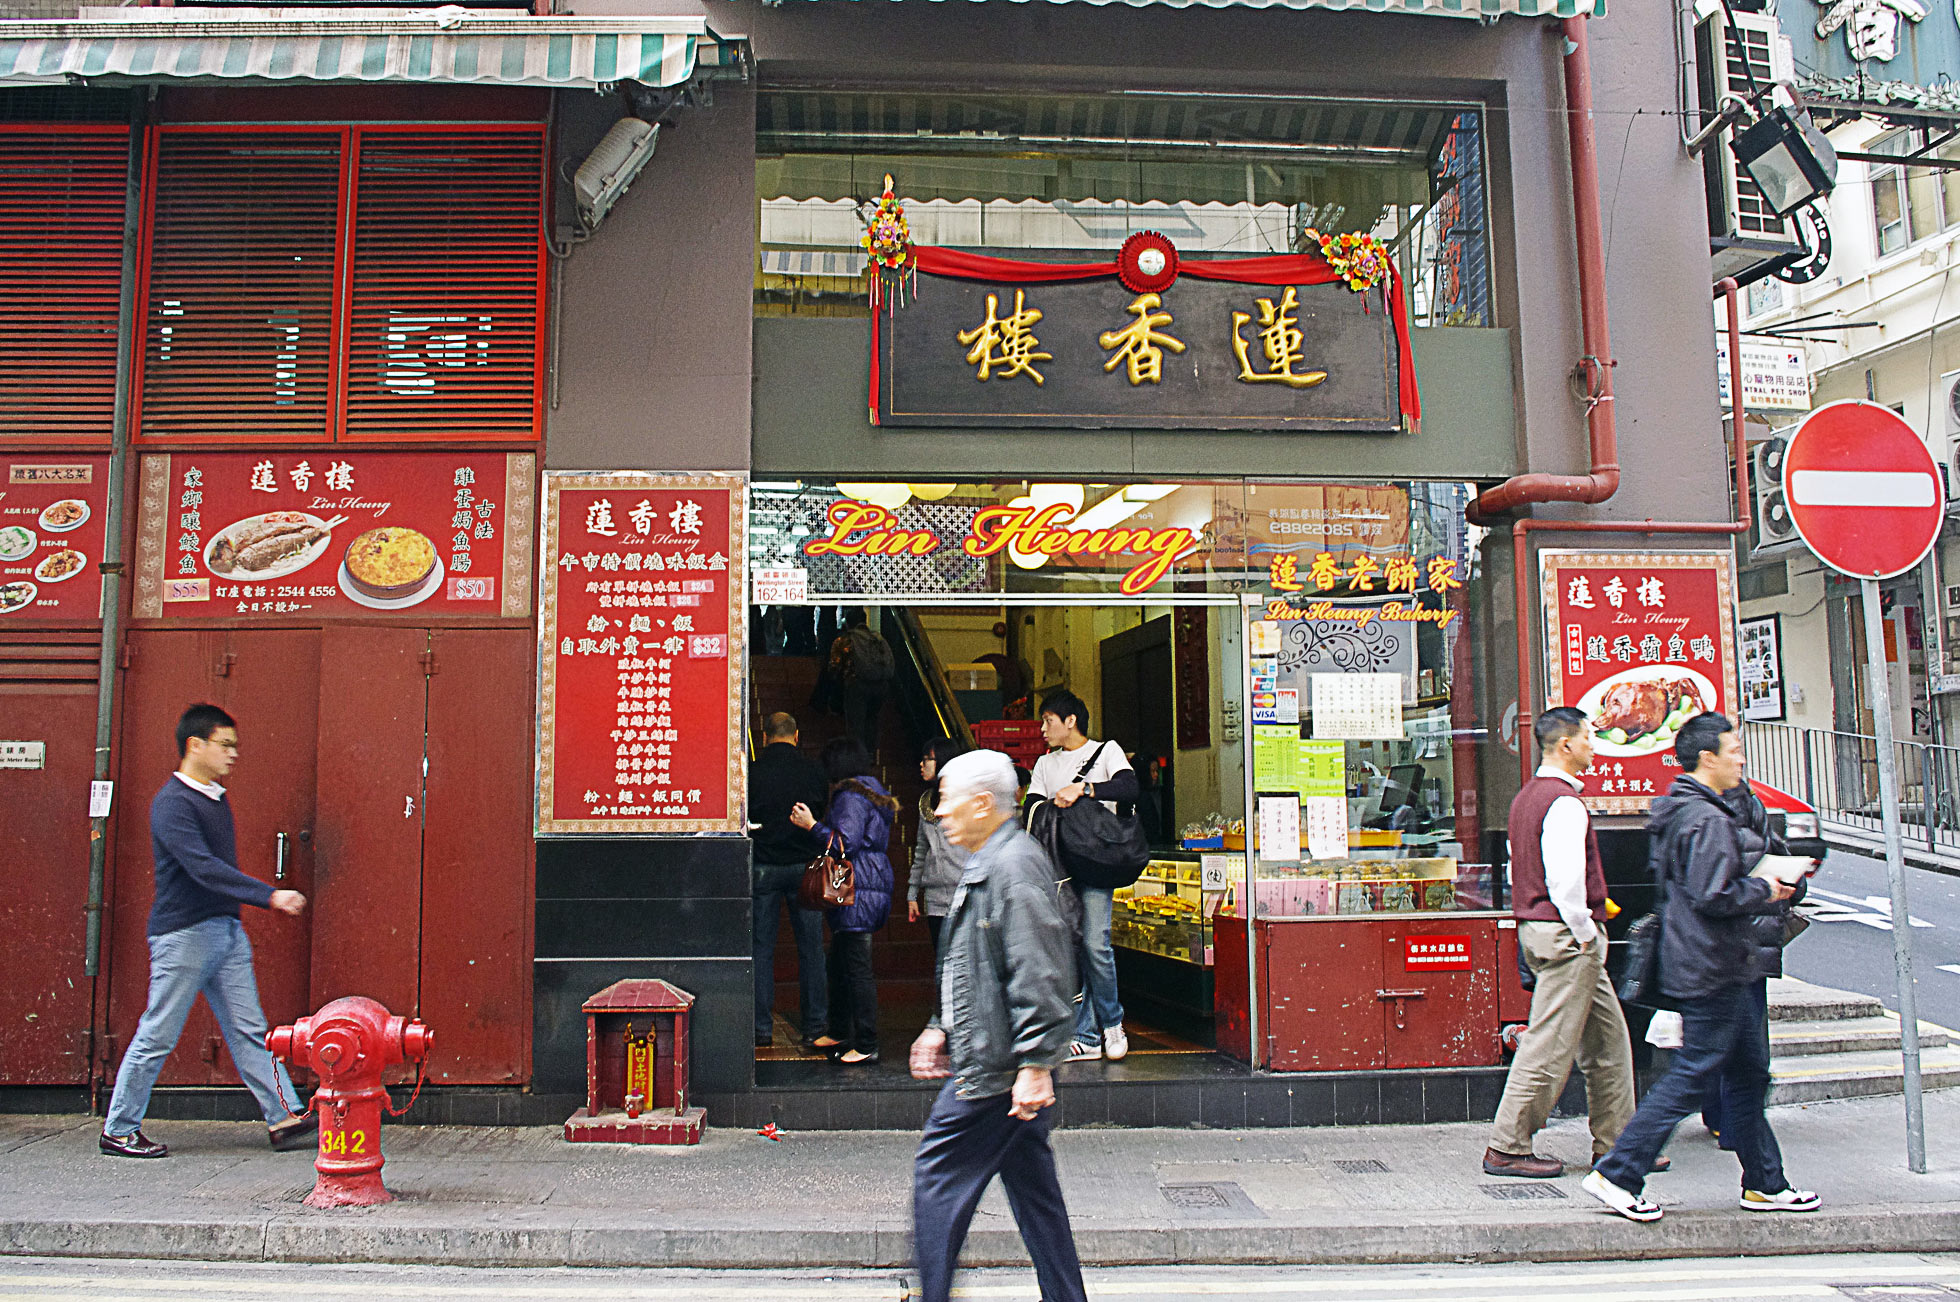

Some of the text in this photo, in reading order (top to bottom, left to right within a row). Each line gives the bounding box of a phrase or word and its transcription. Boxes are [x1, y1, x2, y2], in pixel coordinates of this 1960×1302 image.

[1744, 374, 1806, 387] 心寵物用品店
[1771, 388, 1784, 396] PET
[251, 459, 355, 493] 蓮香樓
[307, 496, 392, 518] Lin Heung
[585, 498, 704, 537] 蓮香樓
[179, 466, 203, 574] 家鄉釀鯪魚
[449, 467, 475, 573] 雞蛋焗魚腸
[474, 499, 496, 539] 古法
[618, 533, 701, 553] Lin Heung
[804, 500, 1202, 597] Lin Heung
[559, 551, 729, 572] 午市特價燒味飯盒
[1269, 552, 1463, 593] 蓮香老餅家
[172, 582, 200, 599] $55
[277, 585, 305, 597] 2544
[308, 585, 337, 597] 4556
[455, 578, 486, 599] $50
[757, 587, 804, 601] 162-164
[1567, 575, 1667, 609] 蓮香樓
[236, 601, 313, 613] 全日不設加一
[1264, 600, 1460, 630] Lin Heung Bakery
[1611, 611, 1690, 632] Lin Heung
[560, 634, 721, 656] 自取外賣一律 $32
[1585, 633, 1716, 663] 蓮香霸皇鴨
[1255, 710, 1276, 718] VISA
[1601, 778, 1656, 793] 提早預定
[634, 1047, 647, 1090] 門口土地財
[321, 1129, 366, 1155] 342
